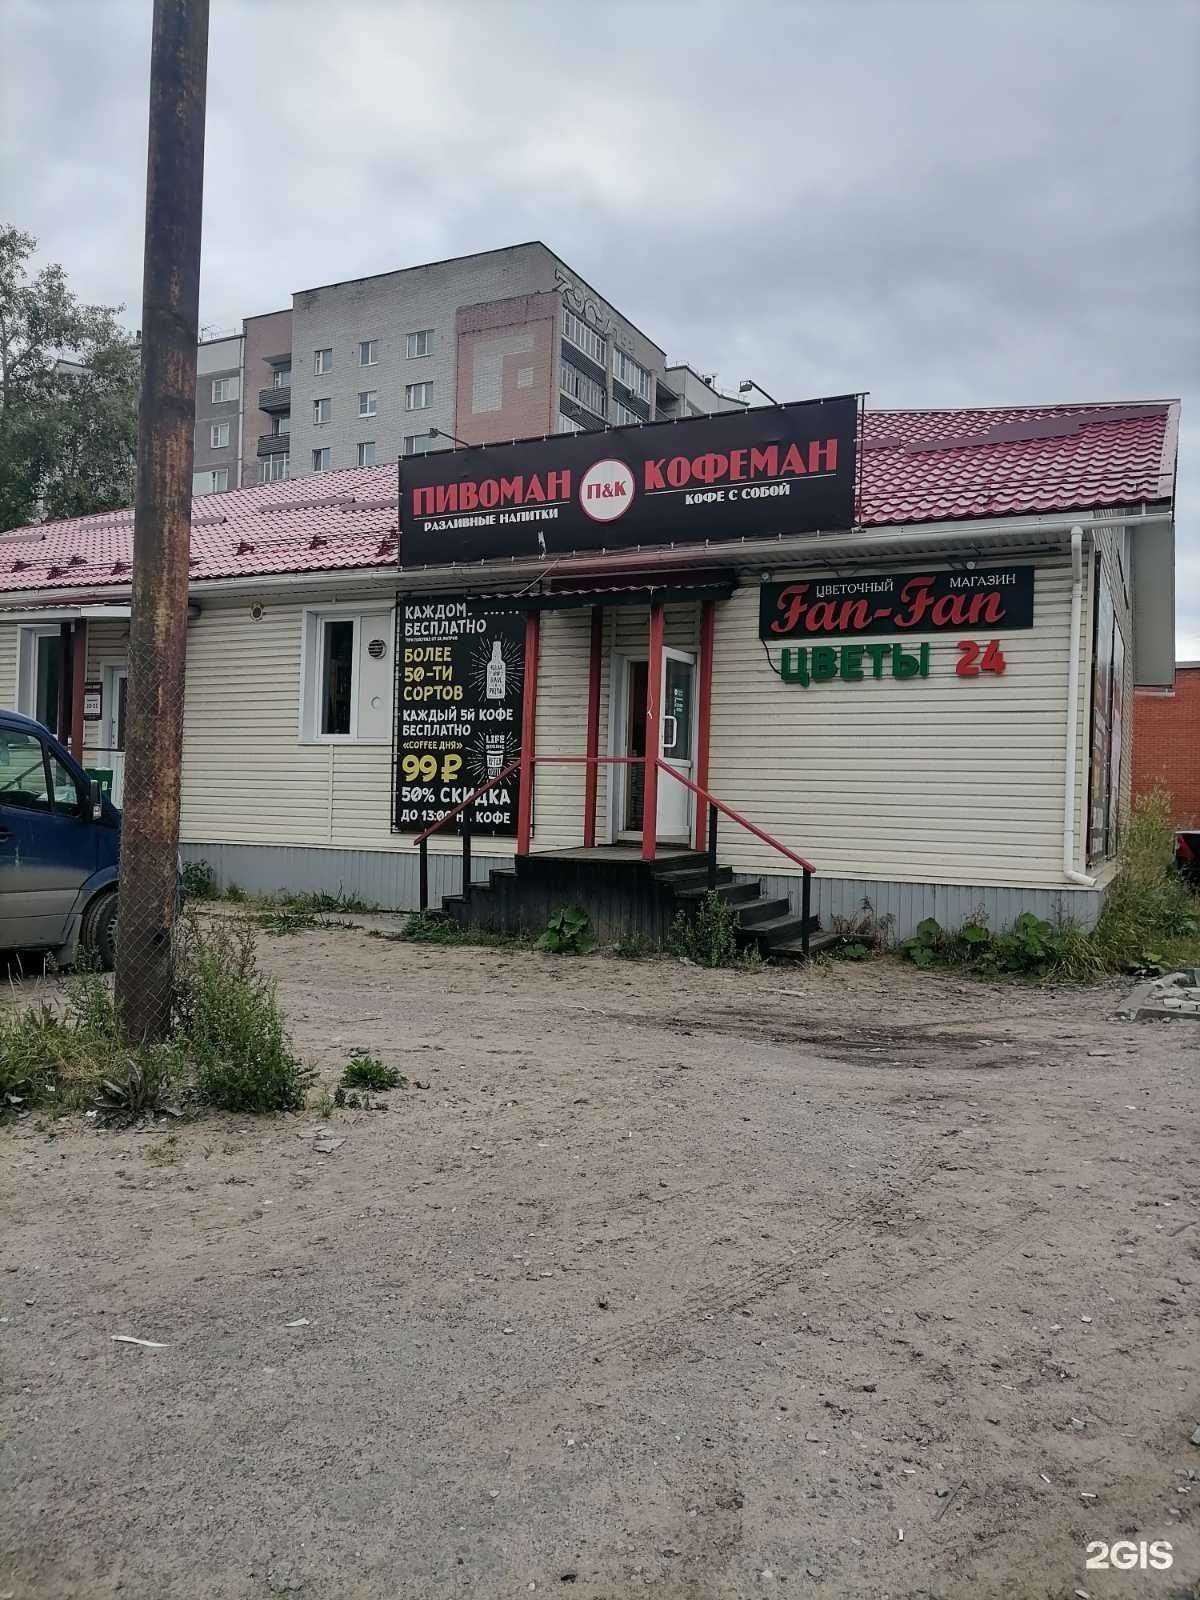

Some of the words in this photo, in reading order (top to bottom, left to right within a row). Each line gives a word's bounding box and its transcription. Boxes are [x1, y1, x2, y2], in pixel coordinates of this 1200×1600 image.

[644, 438, 839, 490] КОФЕМАН
[412, 469, 572, 516] ПИВОМАН
[587, 480, 626, 500] П&К
[685, 490, 725, 505] КОФЕ
[728, 489, 738, 501] С
[741, 482, 791, 499] СОБОЙ
[424, 515, 497, 532] РАЗЛИВНЫЕ
[499, 508, 559, 524] НАПИТКИ
[815, 578, 894, 598] ЦВЕТОЧНЫЙ
[950, 573, 1016, 589] МАГАЗИН
[404, 602, 473, 620] КАЖДОМ
[404, 619, 487, 637] БЕСПЛАТНО
[404, 646, 453, 663] БОЛЕЕ
[780, 641, 930, 688] ЦВЕТЫ
[955, 640, 1006, 678] 24
[404, 665, 453, 682] 50-ТИ
[403, 685, 464, 701] СОРТОВ
[402, 705, 457, 723] КАЖДЫЙ
[479, 707, 514, 721] КОФЕ
[402, 724, 471, 737] БЕСПЛАТНО
[401, 786, 436, 803] 50%
[400, 809, 418, 822] ДО
[475, 810, 512, 824] КОФЕ
